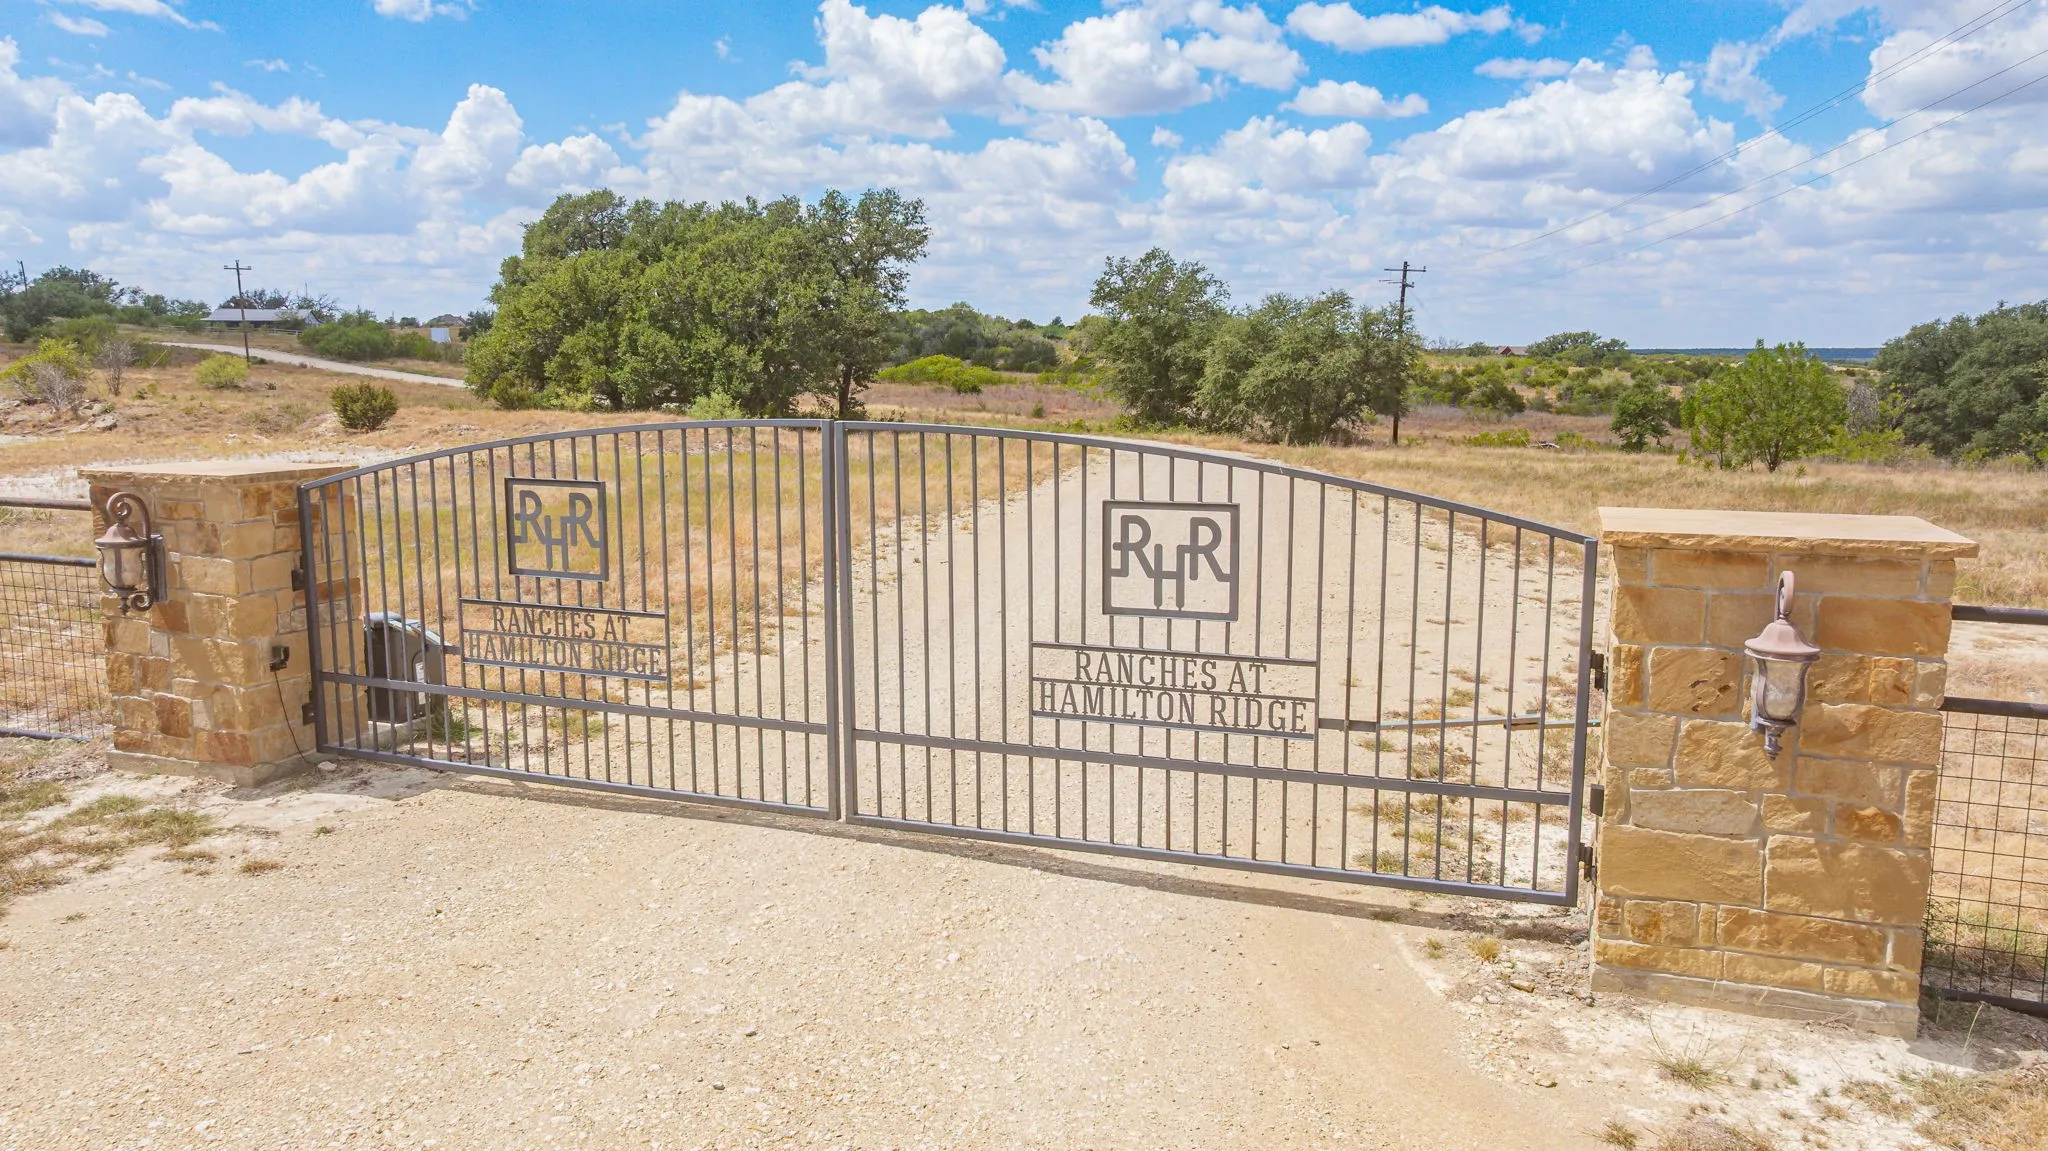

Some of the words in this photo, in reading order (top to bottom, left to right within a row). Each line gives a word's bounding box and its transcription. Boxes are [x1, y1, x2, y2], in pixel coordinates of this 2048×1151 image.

[514, 490, 600, 571] RHR
[1112, 515, 1231, 609] RHR
[493, 606, 596, 640] RANCHES
[603, 614, 631, 642] AT
[469, 632, 582, 668] HAMILTON
[592, 645, 662, 675] RIDGE
[1075, 651, 1217, 692] RANCHES
[1228, 661, 1267, 694] AT
[1039, 681, 1196, 724] HAMILTON
[1209, 695, 1307, 734] RIDGE
